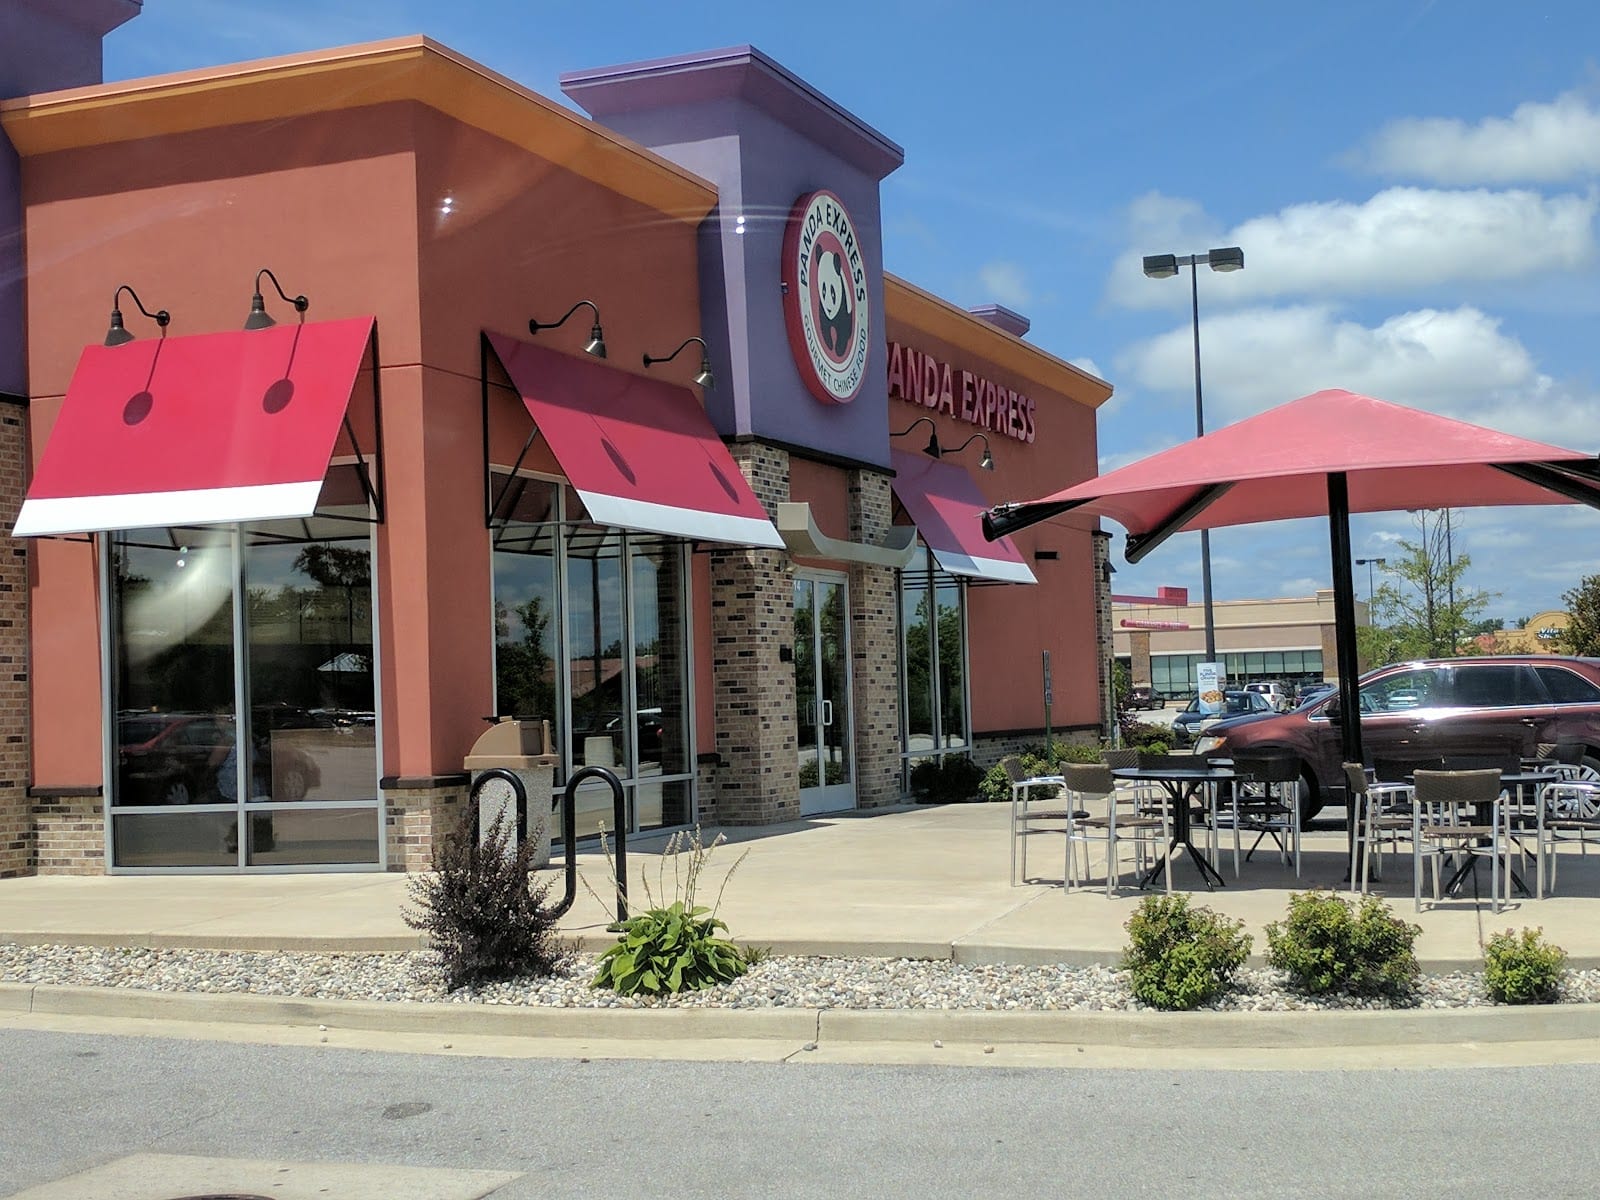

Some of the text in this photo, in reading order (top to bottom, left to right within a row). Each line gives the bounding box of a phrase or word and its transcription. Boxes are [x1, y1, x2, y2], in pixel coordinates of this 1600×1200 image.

[800, 203, 866, 302] PANDA EXPRESS
[804, 314, 867, 393] GOURMET CHINESE FOOD
[886, 342, 1036, 444] ANDA EXPRESS
